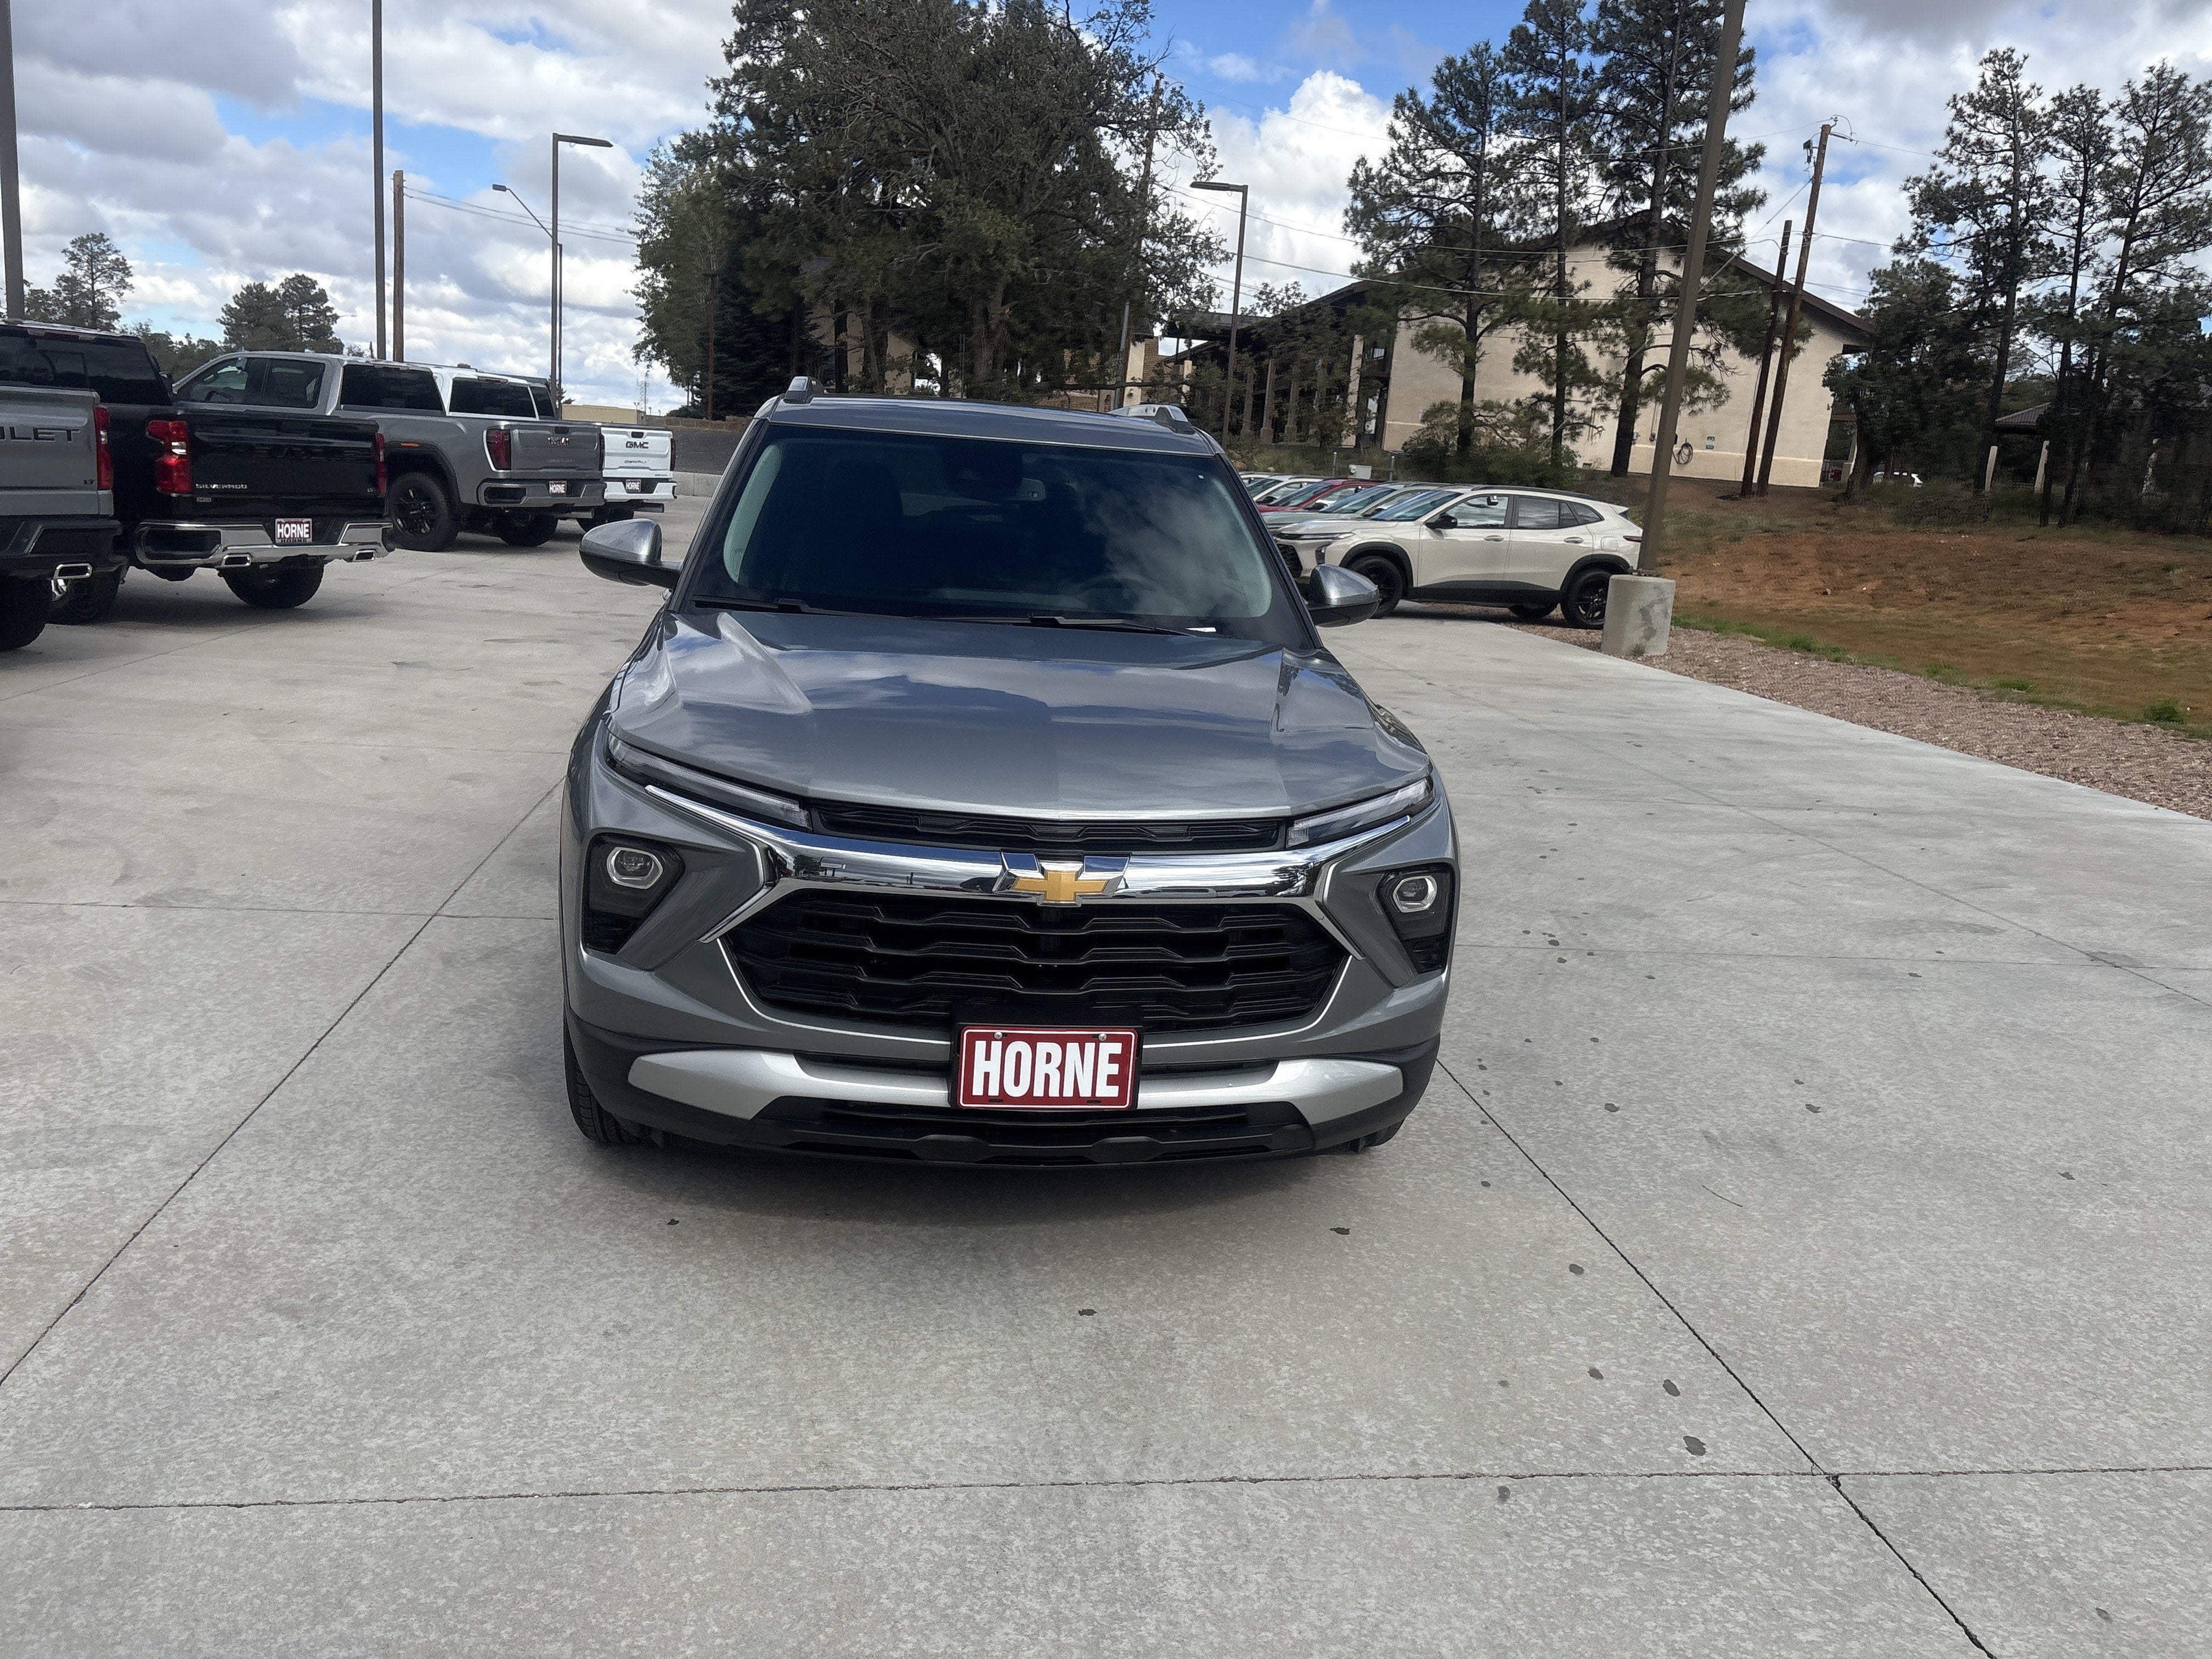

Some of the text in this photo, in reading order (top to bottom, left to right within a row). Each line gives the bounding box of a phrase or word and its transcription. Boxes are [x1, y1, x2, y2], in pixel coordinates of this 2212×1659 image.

[0, 426, 81, 443] LET
[549, 484, 565, 493] HORNE
[277, 523, 309, 538] HORNE
[972, 1040, 1122, 1097] HORNE
